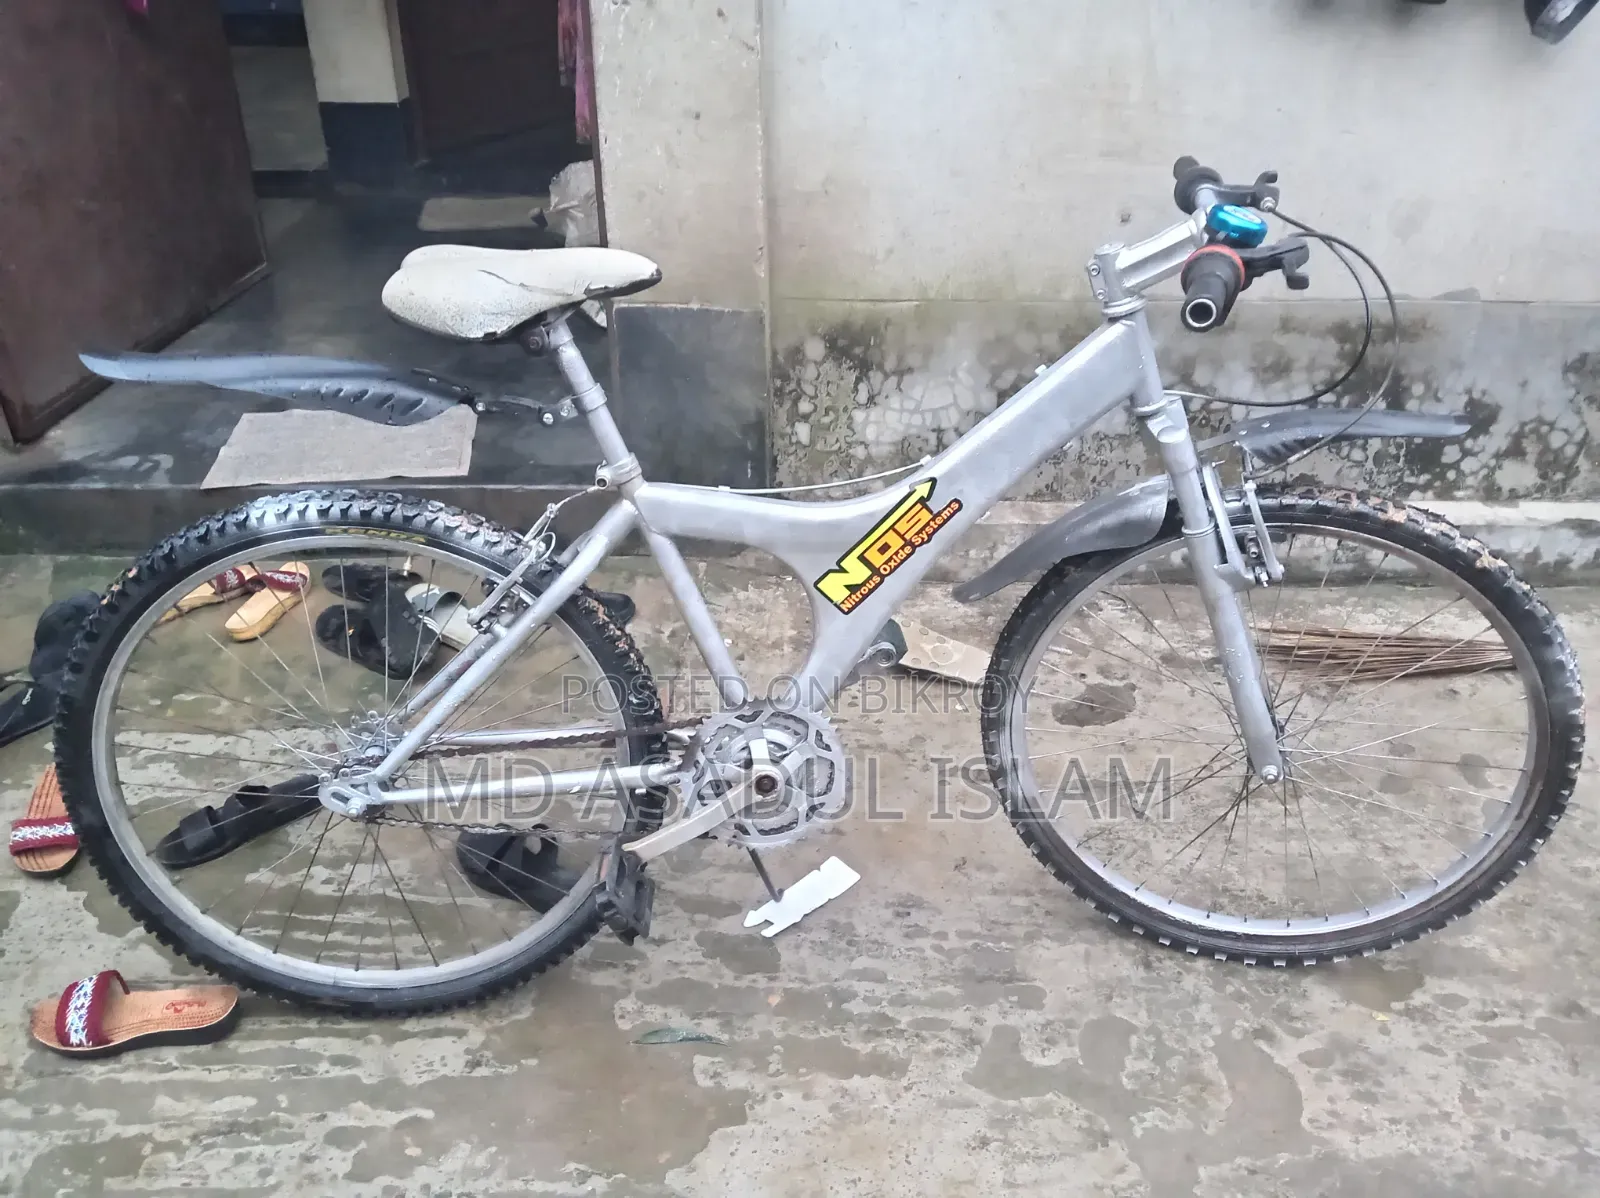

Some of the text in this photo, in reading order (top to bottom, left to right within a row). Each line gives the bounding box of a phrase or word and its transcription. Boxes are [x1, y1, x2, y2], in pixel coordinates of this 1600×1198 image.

[815, 480, 934, 604] NOS
[839, 575, 881, 613] Nitrous
[912, 500, 959, 546] Systems
